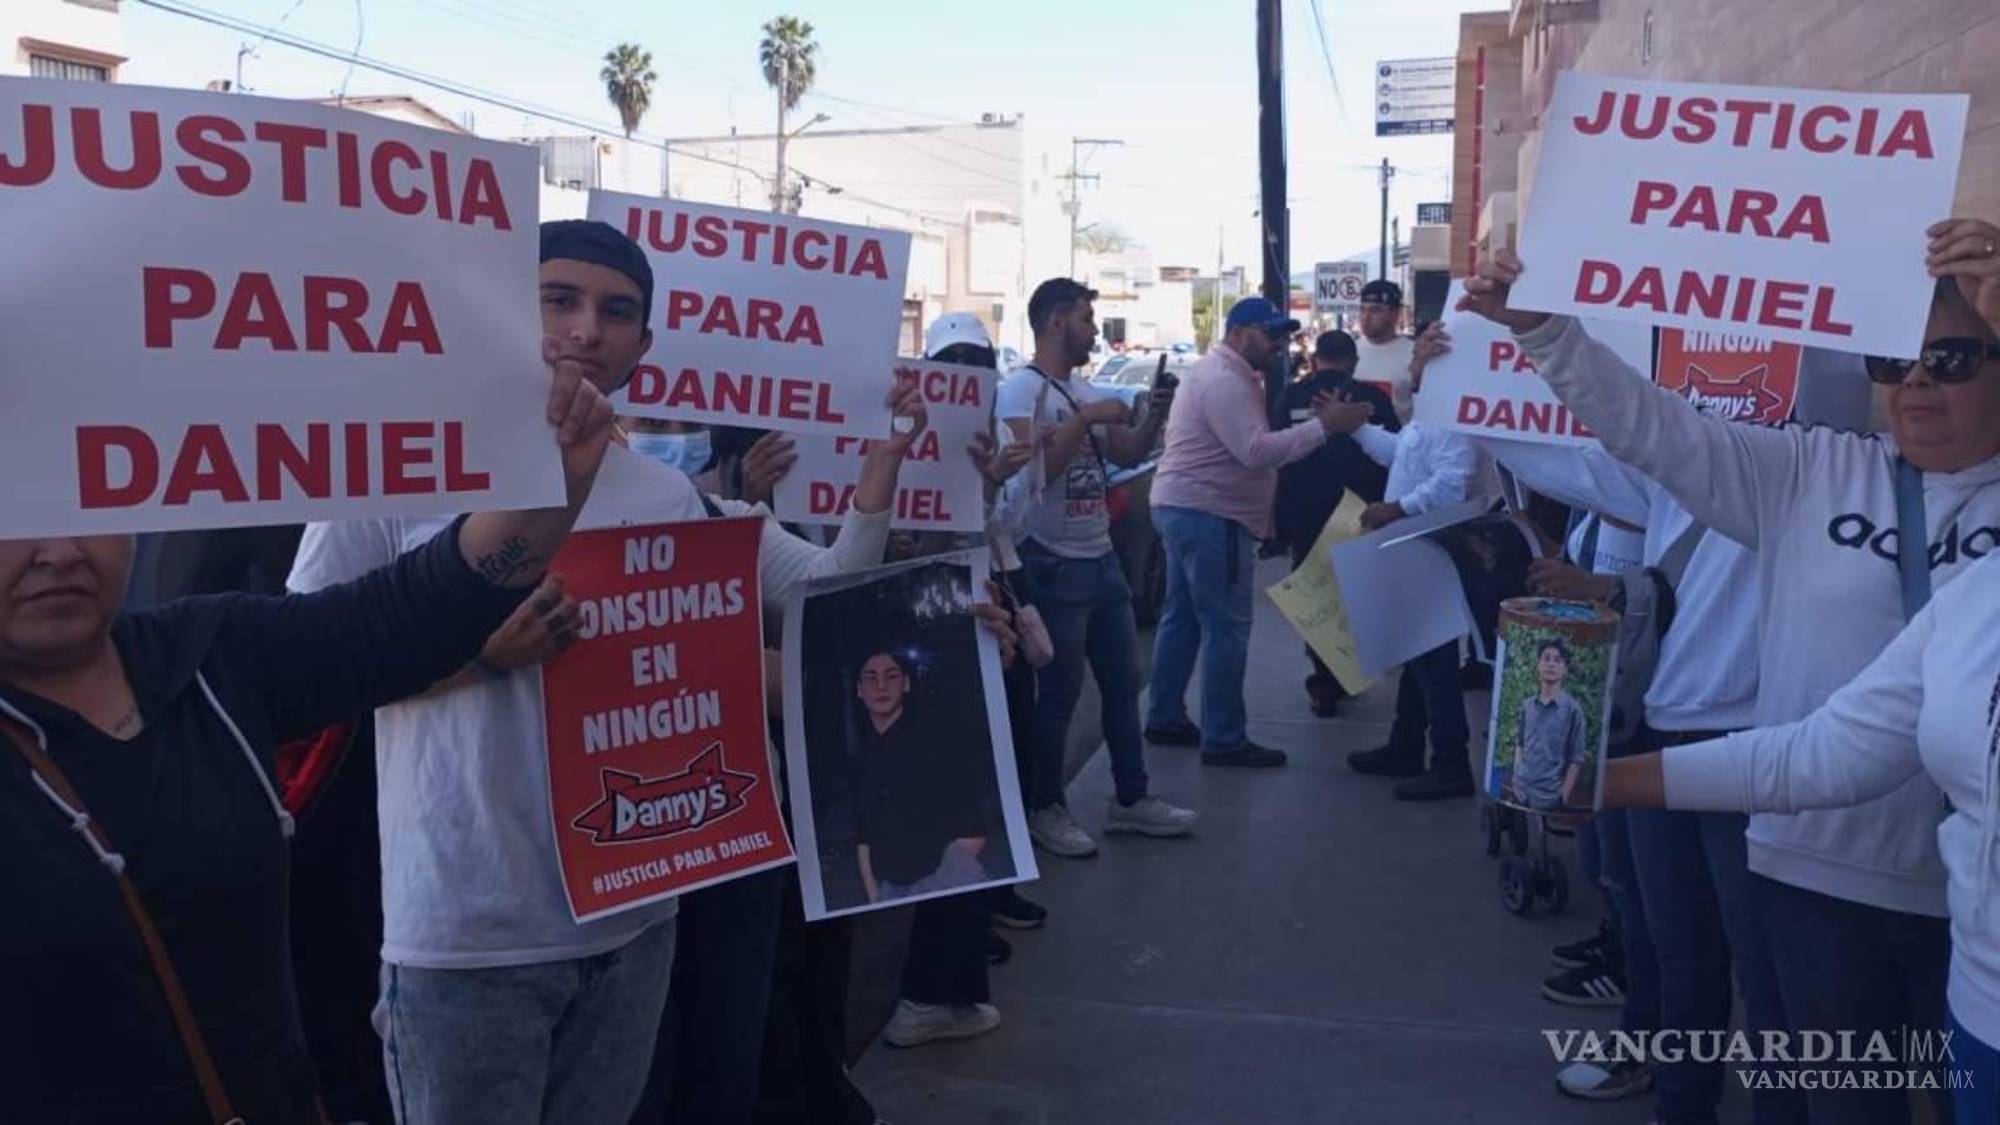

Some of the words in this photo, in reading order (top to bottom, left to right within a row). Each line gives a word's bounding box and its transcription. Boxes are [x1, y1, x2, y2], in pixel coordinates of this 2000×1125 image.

[1573, 92, 1935, 159] JUSTICIA
[0, 104, 512, 231] JUSTICIA
[1630, 181, 1830, 243] PARA
[143, 266, 444, 355] PARA
[666, 291, 824, 346] PARA
[1319, 279, 1338, 299] NO
[1573, 260, 1854, 336] DANIEL
[628, 365, 845, 423] DANIEL
[76, 421, 490, 510] DANIEL
[625, 535, 674, 575] NO
[579, 578, 745, 640] ONSUMAS
[631, 643, 677, 686] EN
[583, 689, 721, 754] NINGÚN
[616, 777, 727, 834] Danny's
[593, 858, 670, 895] #JUSTICIA
[674, 847, 717, 872] PARA
[720, 832, 773, 859] DANIEL
